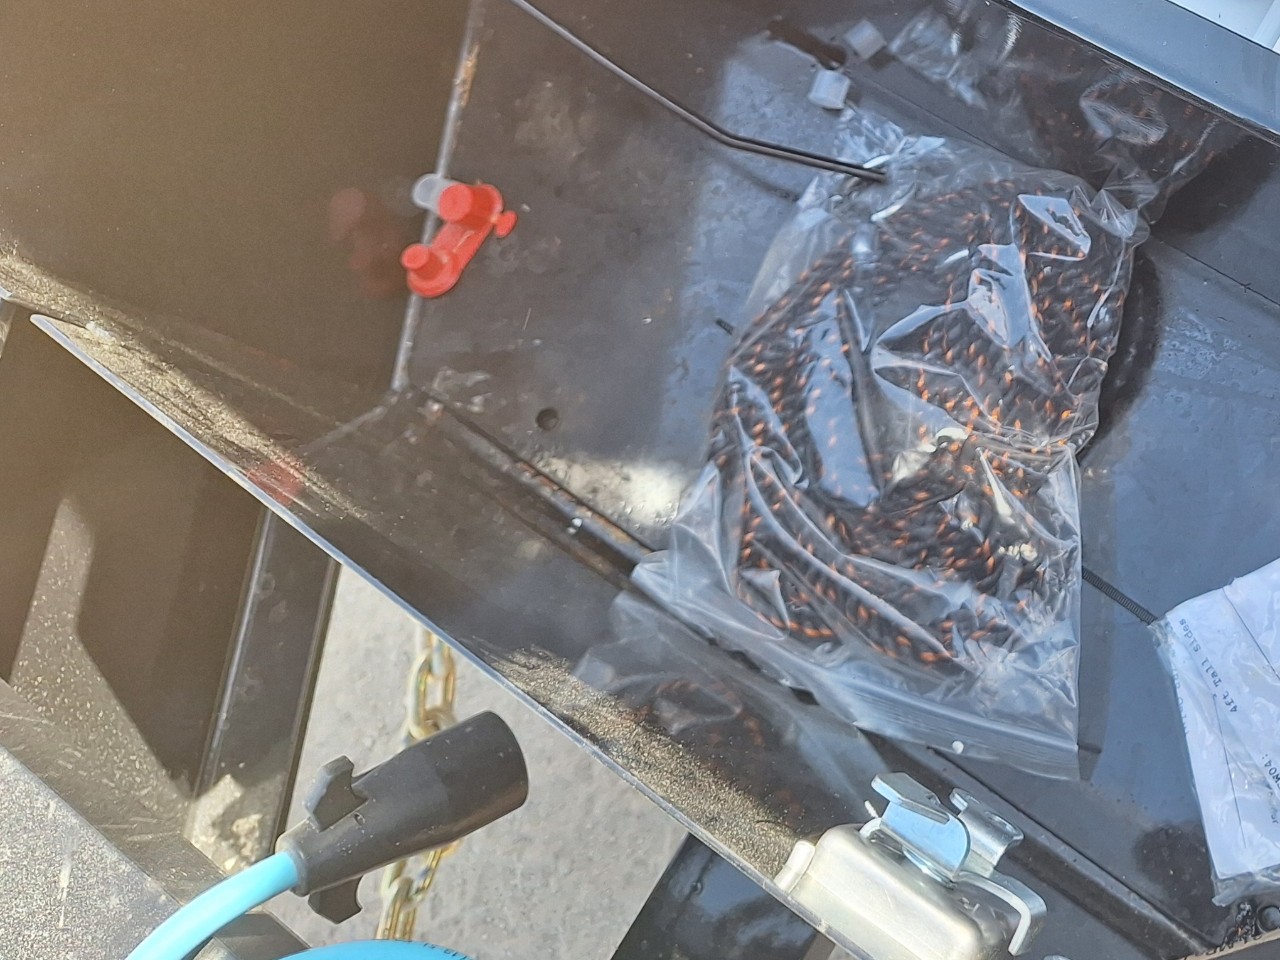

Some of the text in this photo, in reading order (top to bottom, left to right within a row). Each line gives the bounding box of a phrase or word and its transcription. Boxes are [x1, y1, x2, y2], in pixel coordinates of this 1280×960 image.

[1176, 617, 1202, 652] Sides
[1199, 656, 1223, 687] Tall
[1220, 689, 1240, 713] 4ft
